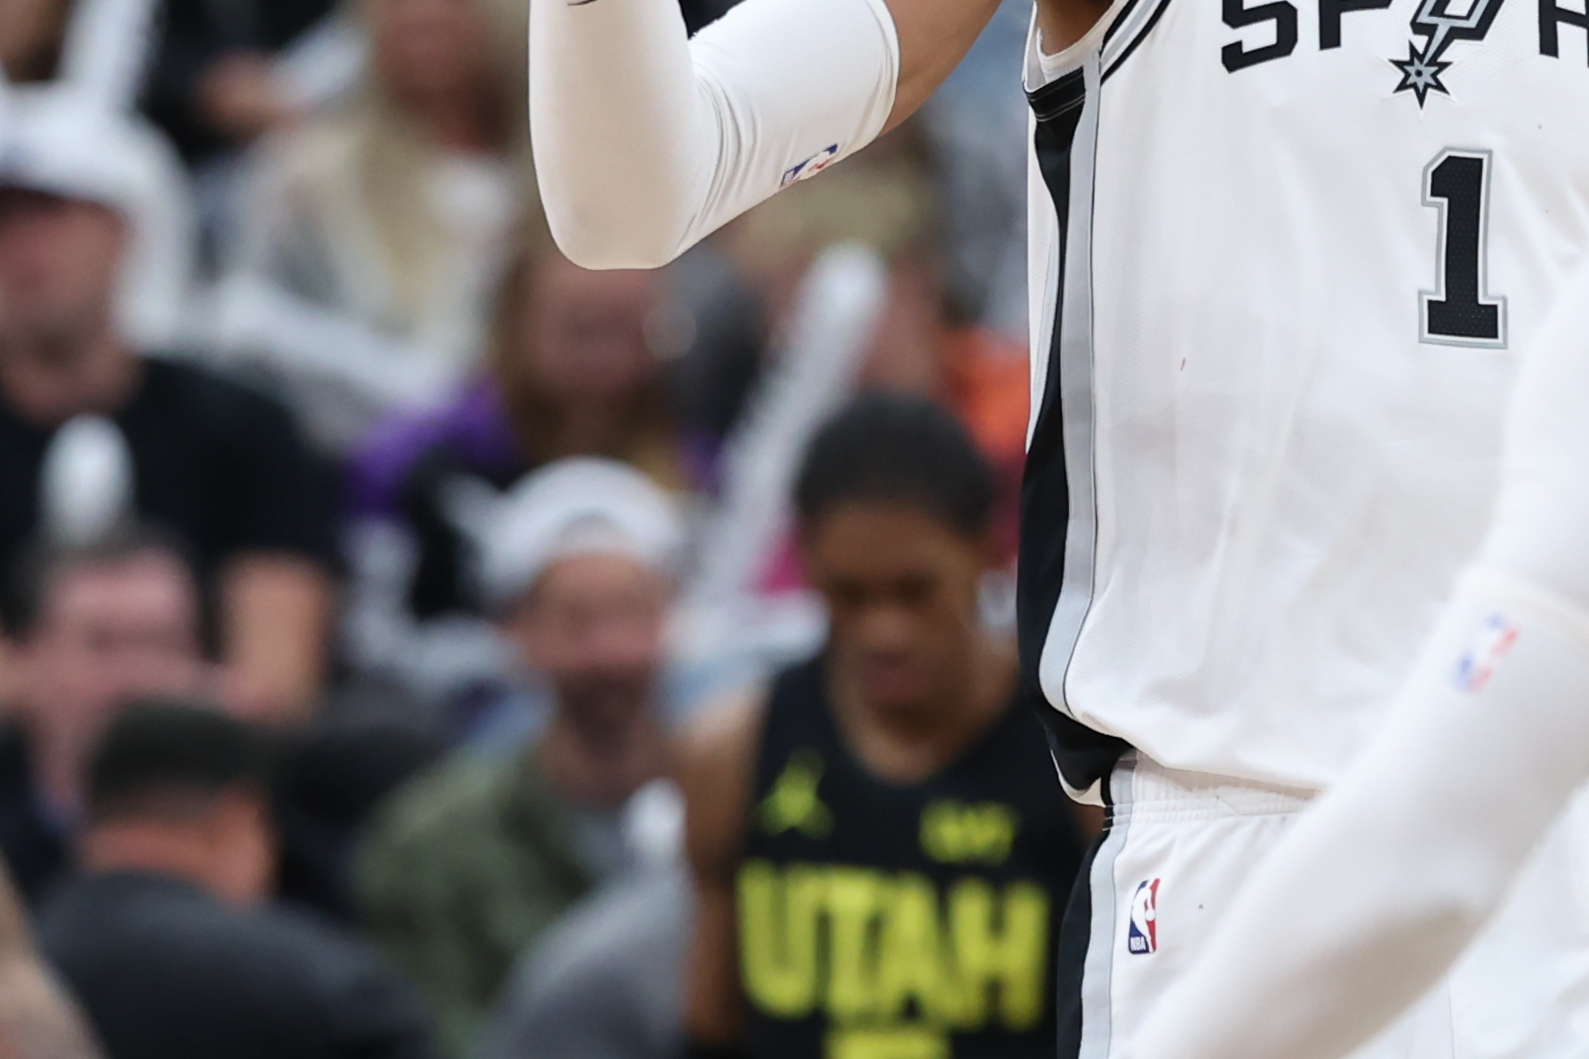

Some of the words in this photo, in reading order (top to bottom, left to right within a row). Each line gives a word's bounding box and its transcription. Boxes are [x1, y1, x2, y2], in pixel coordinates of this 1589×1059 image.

[1418, 146, 1508, 349] 1
[738, 858, 1049, 1030] UTAH
[1130, 936, 1146, 951] NBA
